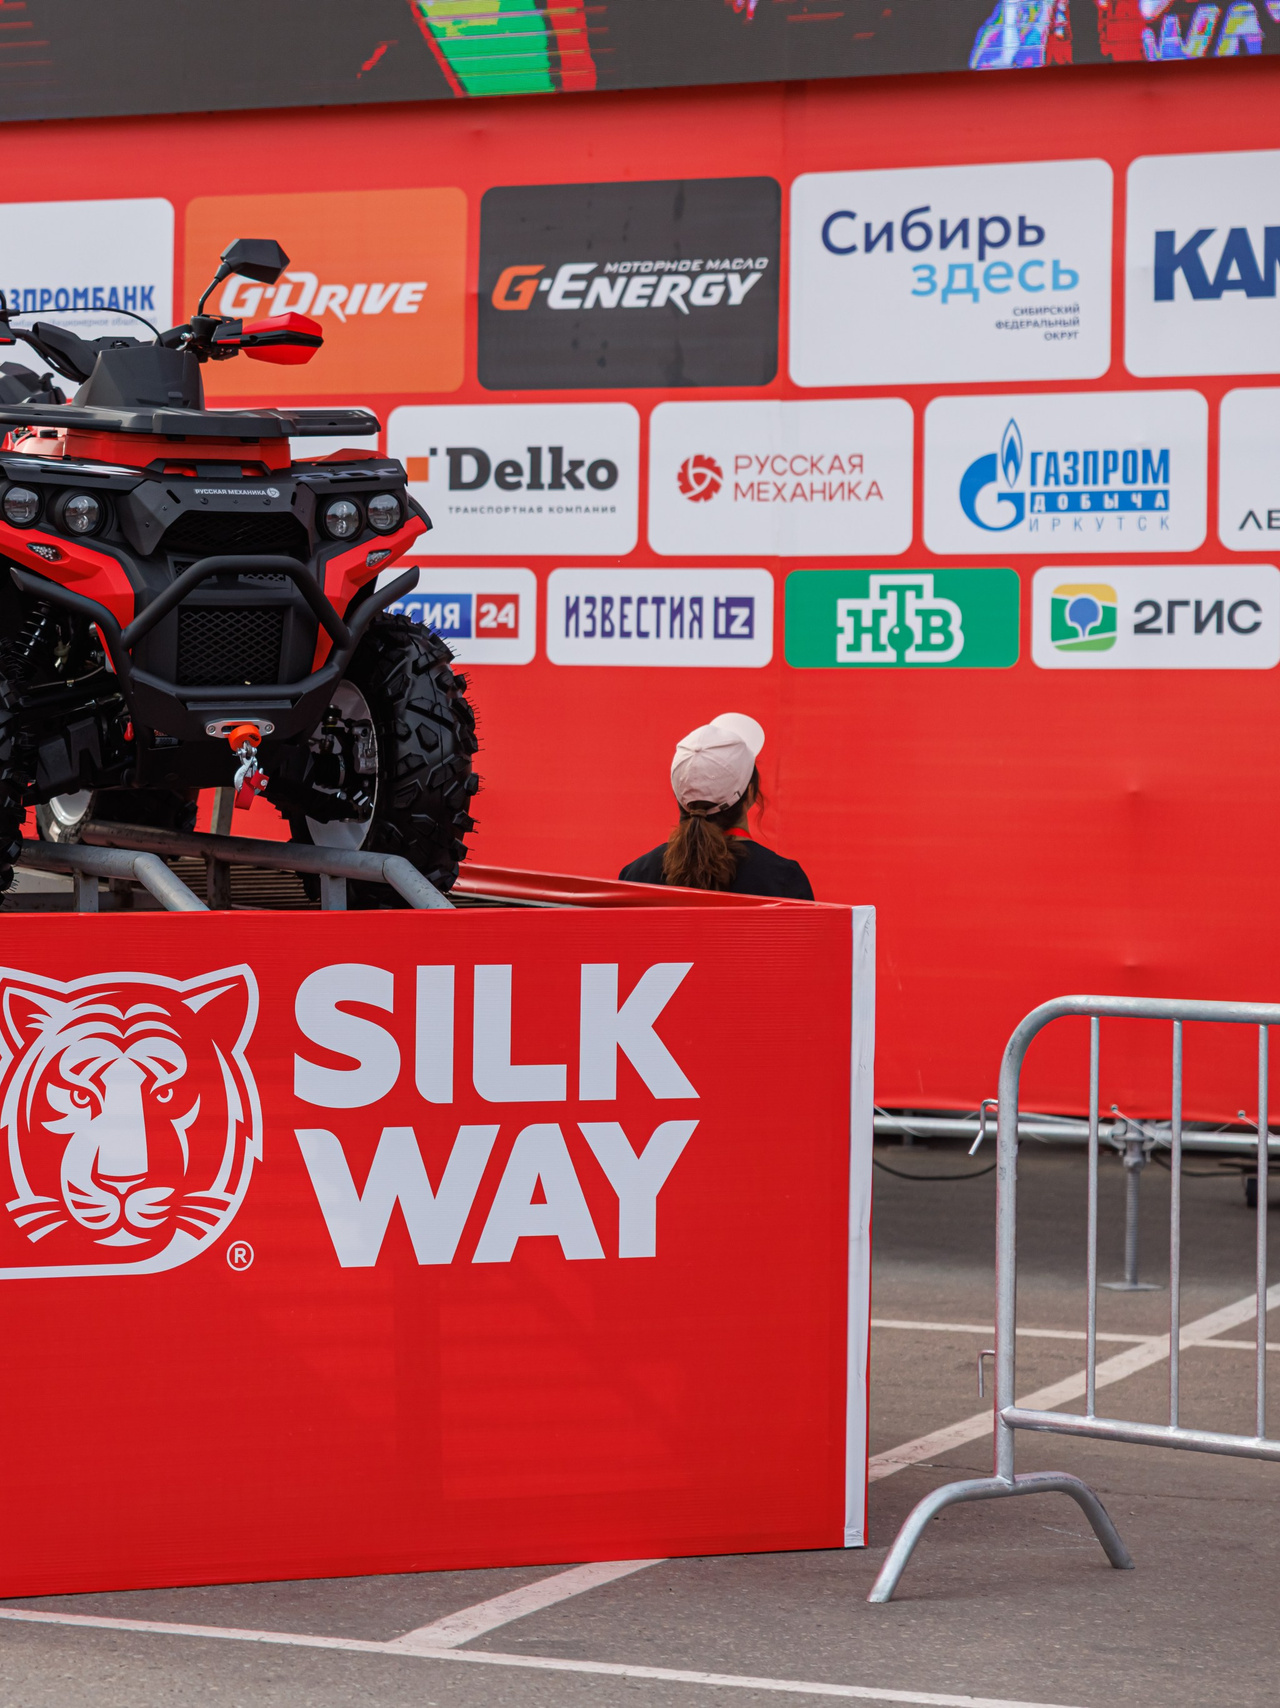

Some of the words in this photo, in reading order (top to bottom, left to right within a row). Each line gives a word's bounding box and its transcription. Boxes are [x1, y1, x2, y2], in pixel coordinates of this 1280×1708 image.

[820, 205, 1046, 263] Сибирь
[603, 258, 704, 274] МОТОРНОЕ
[705, 256, 770, 271] МАСЛО
[910, 258, 1080, 304] здесь
[1011, 303, 1081, 317] СИБИРСКИЙ
[994, 316, 1081, 331] ФЕДЕРАЛЬНЫЙ
[1043, 330, 1080, 342] ОКРУГ
[445, 445, 619, 492] Delko
[733, 453, 865, 477] РУССКАЯ
[1029, 448, 1171, 487] ГАЗПРОМ
[193, 488, 228, 496] РУССКАЯ
[227, 488, 267, 497] МЕХАНИКА
[733, 479, 885, 503] МЕХАНИКА
[1032, 491, 1167, 513] ДОБЫЧА
[447, 505, 544, 515] ТРАНСПОРТНАЯ
[548, 505, 617, 515] КОМПАНИЯ
[1028, 515, 1170, 533] ИРКУТСК
[478, 602, 516, 629] 24
[564, 594, 704, 640] ИЗВЕСТИЯ
[1133, 599, 1263, 635] 2ГИС
[293, 961, 701, 1109] SILK
[293, 1119, 700, 1269] WAY
